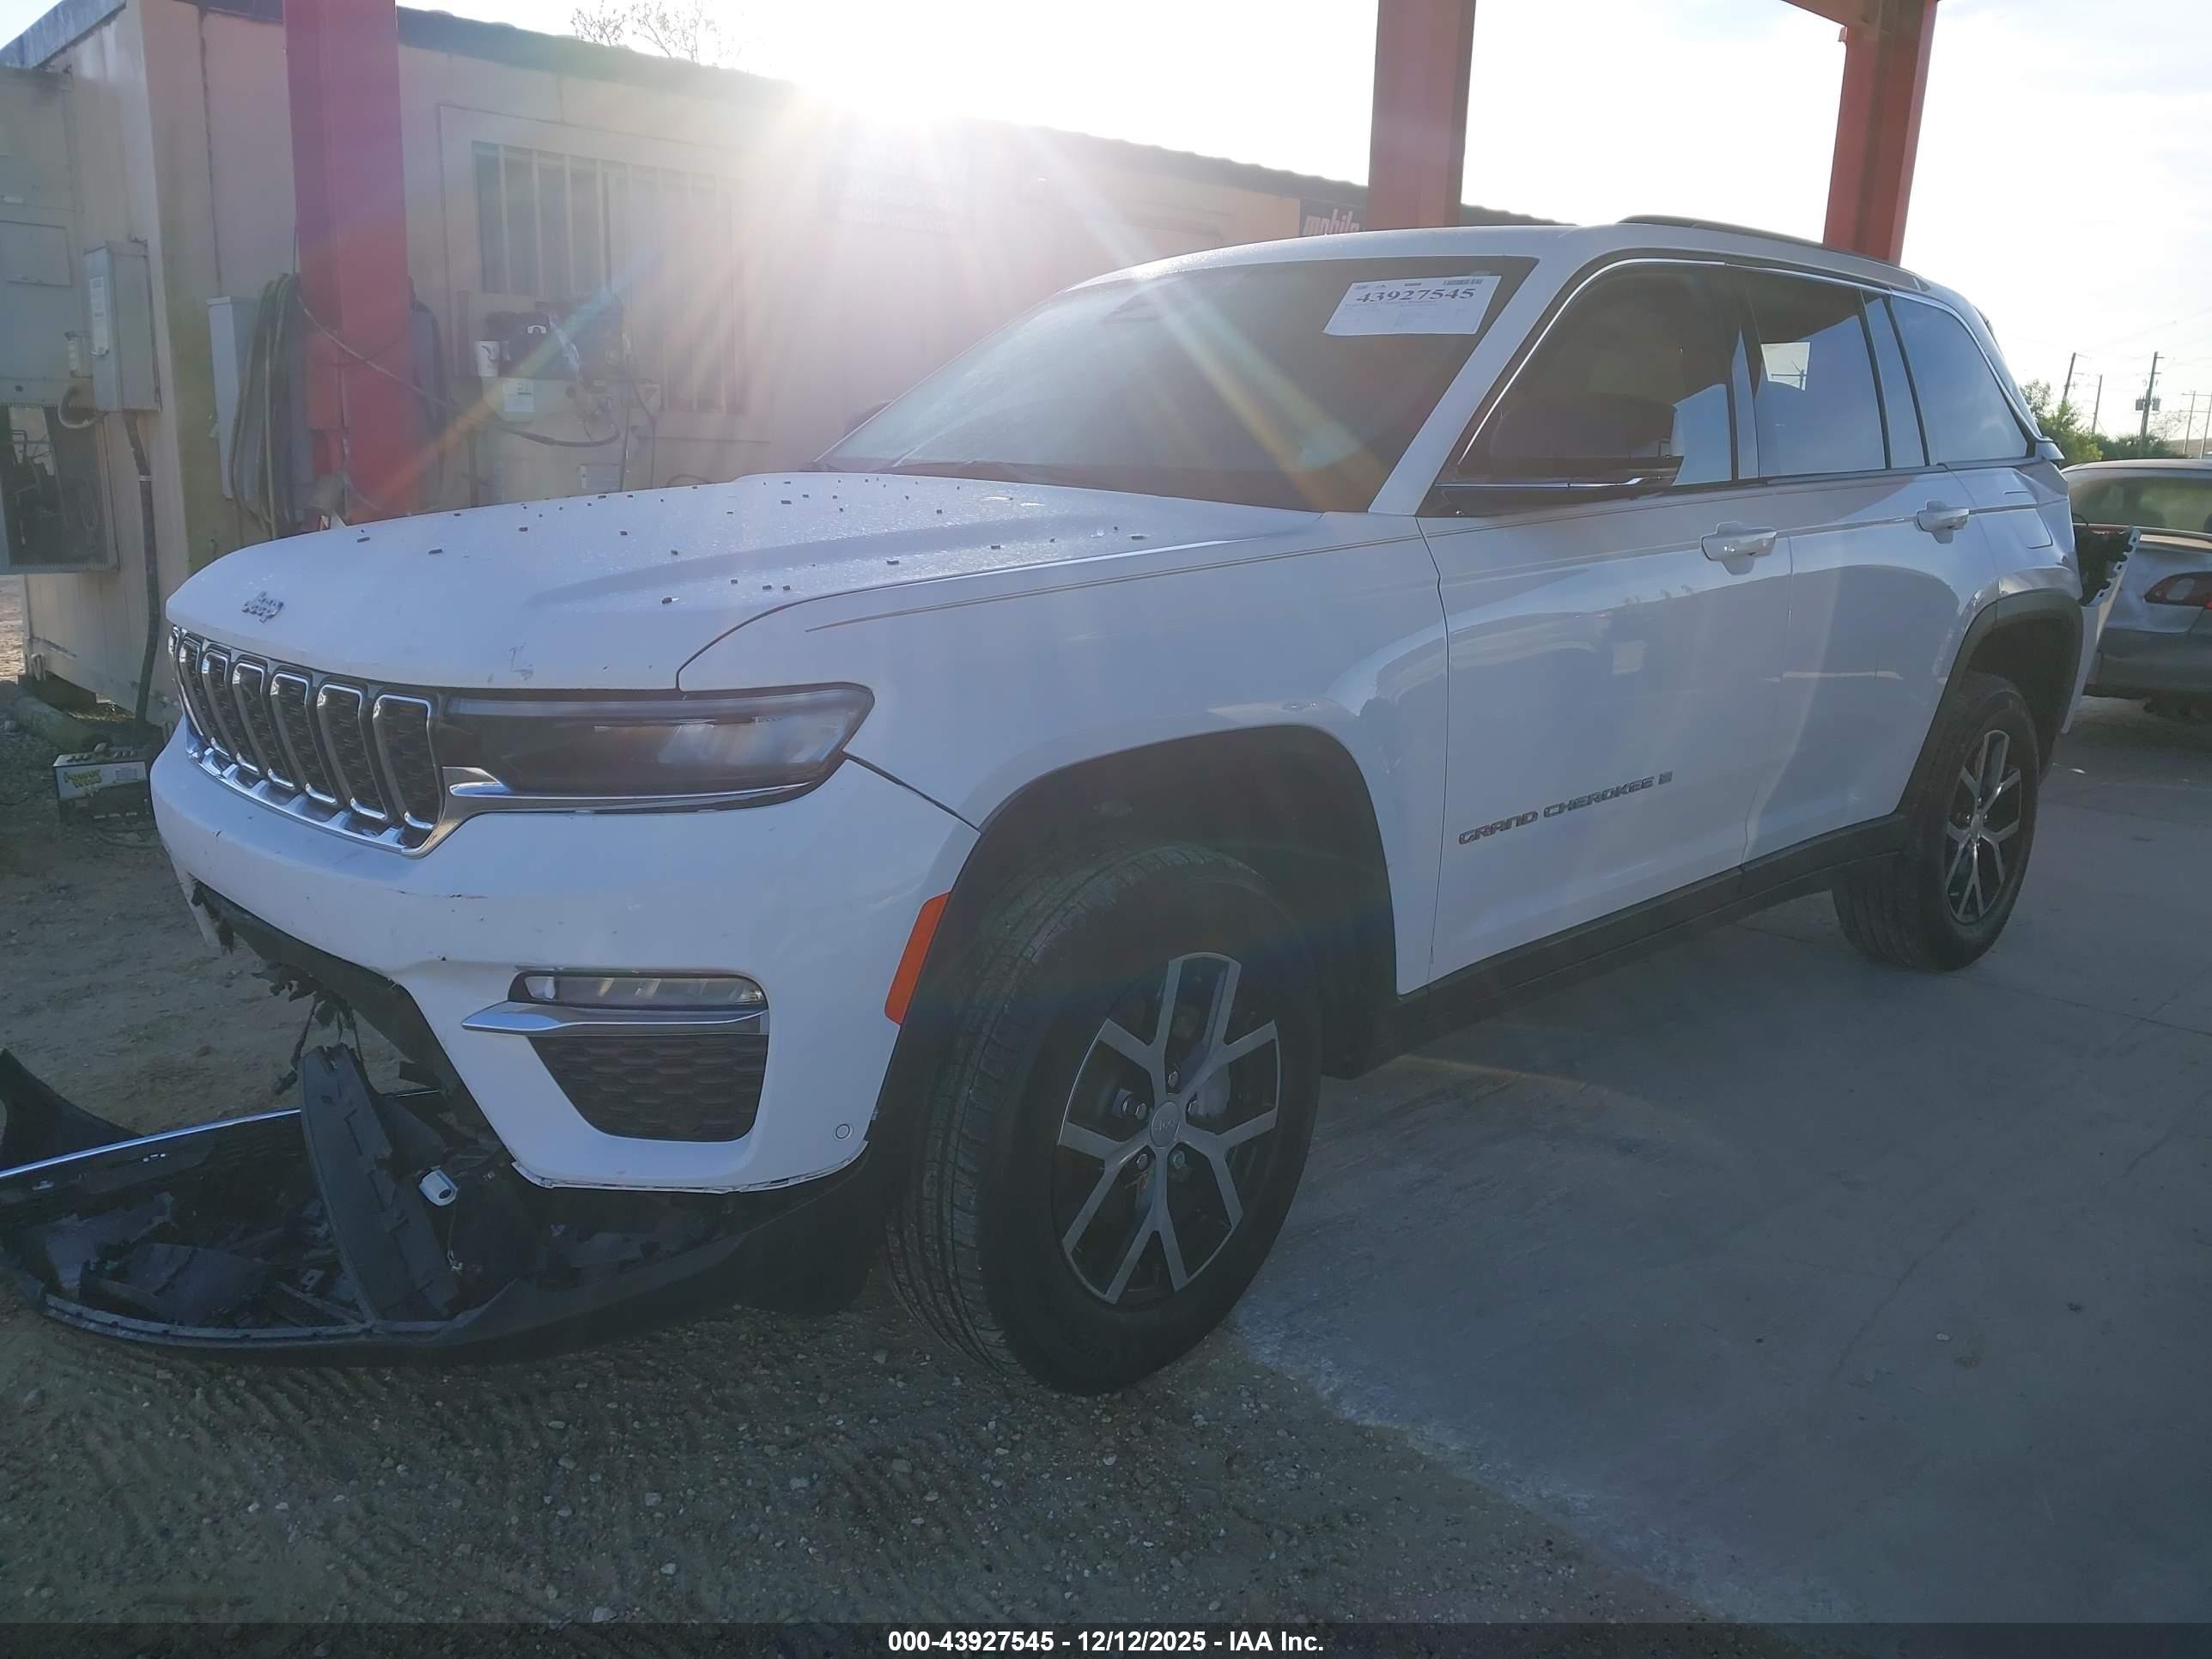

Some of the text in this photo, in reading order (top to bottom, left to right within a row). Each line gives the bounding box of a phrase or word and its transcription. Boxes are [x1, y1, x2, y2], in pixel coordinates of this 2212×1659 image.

[1356, 288, 1476, 302] 43927545
[1458, 775, 1656, 846] GRAND CHEROKEE
